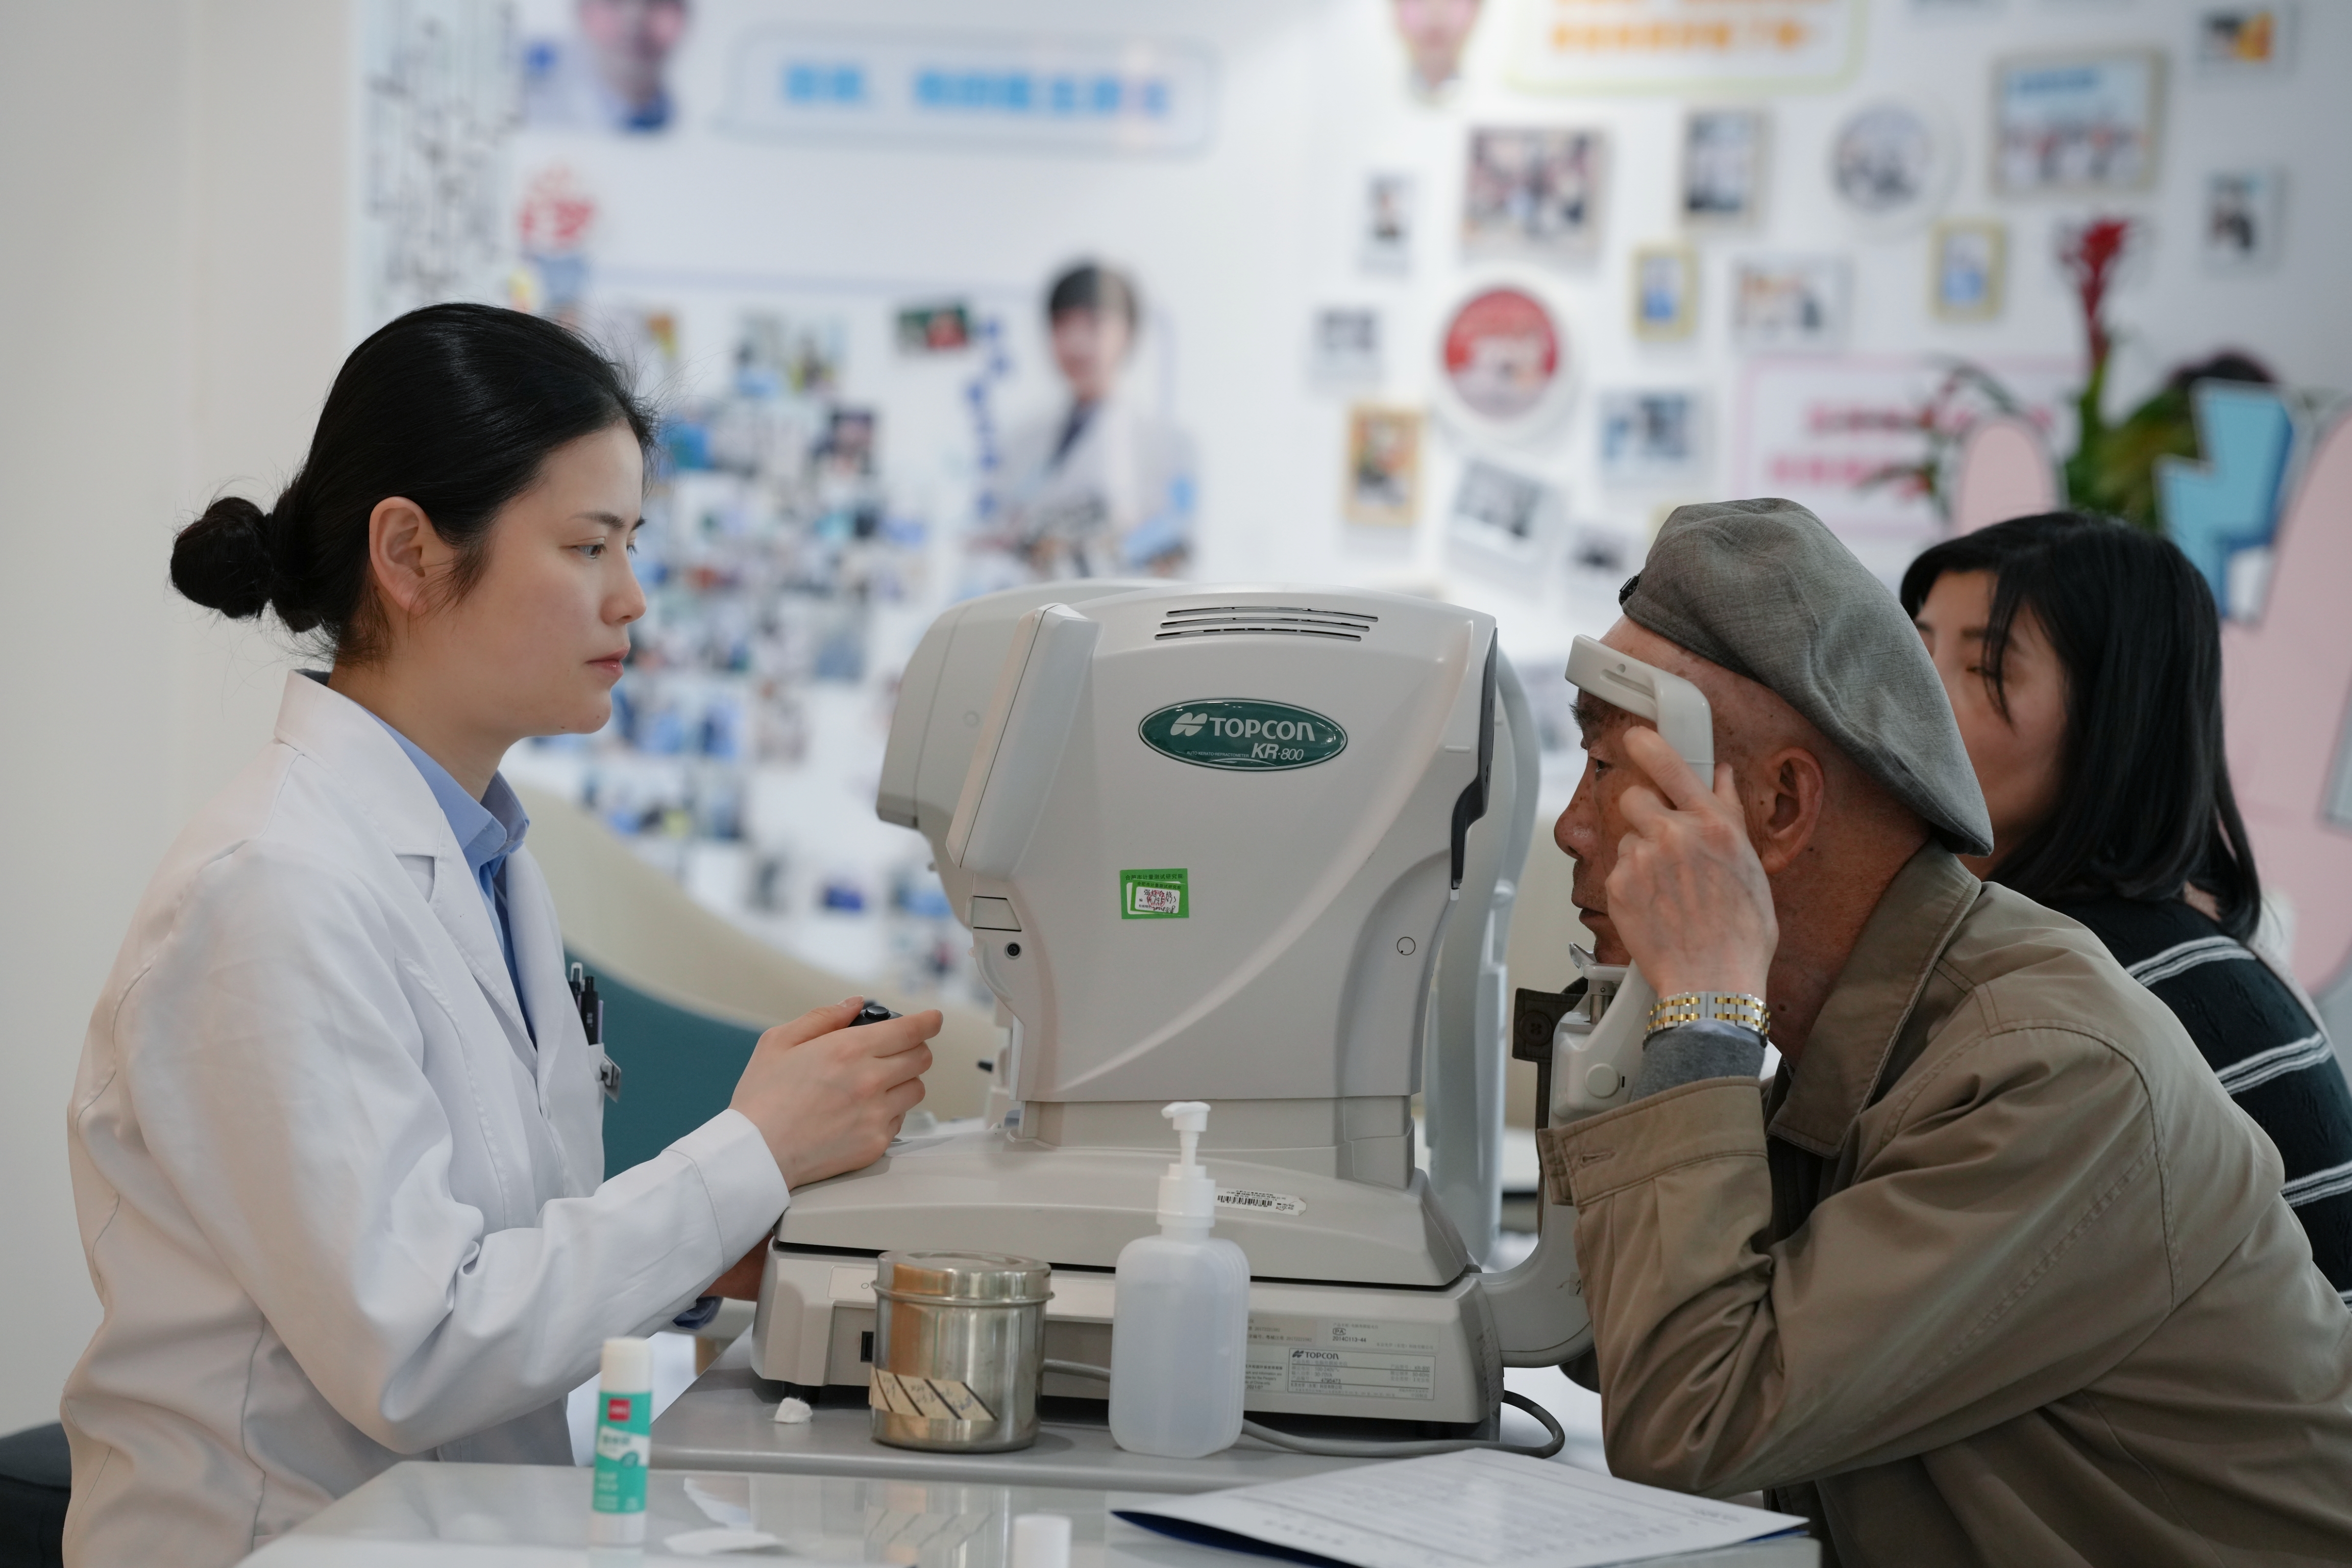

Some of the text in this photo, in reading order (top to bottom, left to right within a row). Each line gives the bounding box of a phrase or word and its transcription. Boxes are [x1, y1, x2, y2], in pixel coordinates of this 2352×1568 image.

[1209, 717, 1315, 742] TOPCON
[1137, 881, 1182, 890] 合肥市计量测试研究院
[1305, 1352, 1339, 1360] TOPCON
